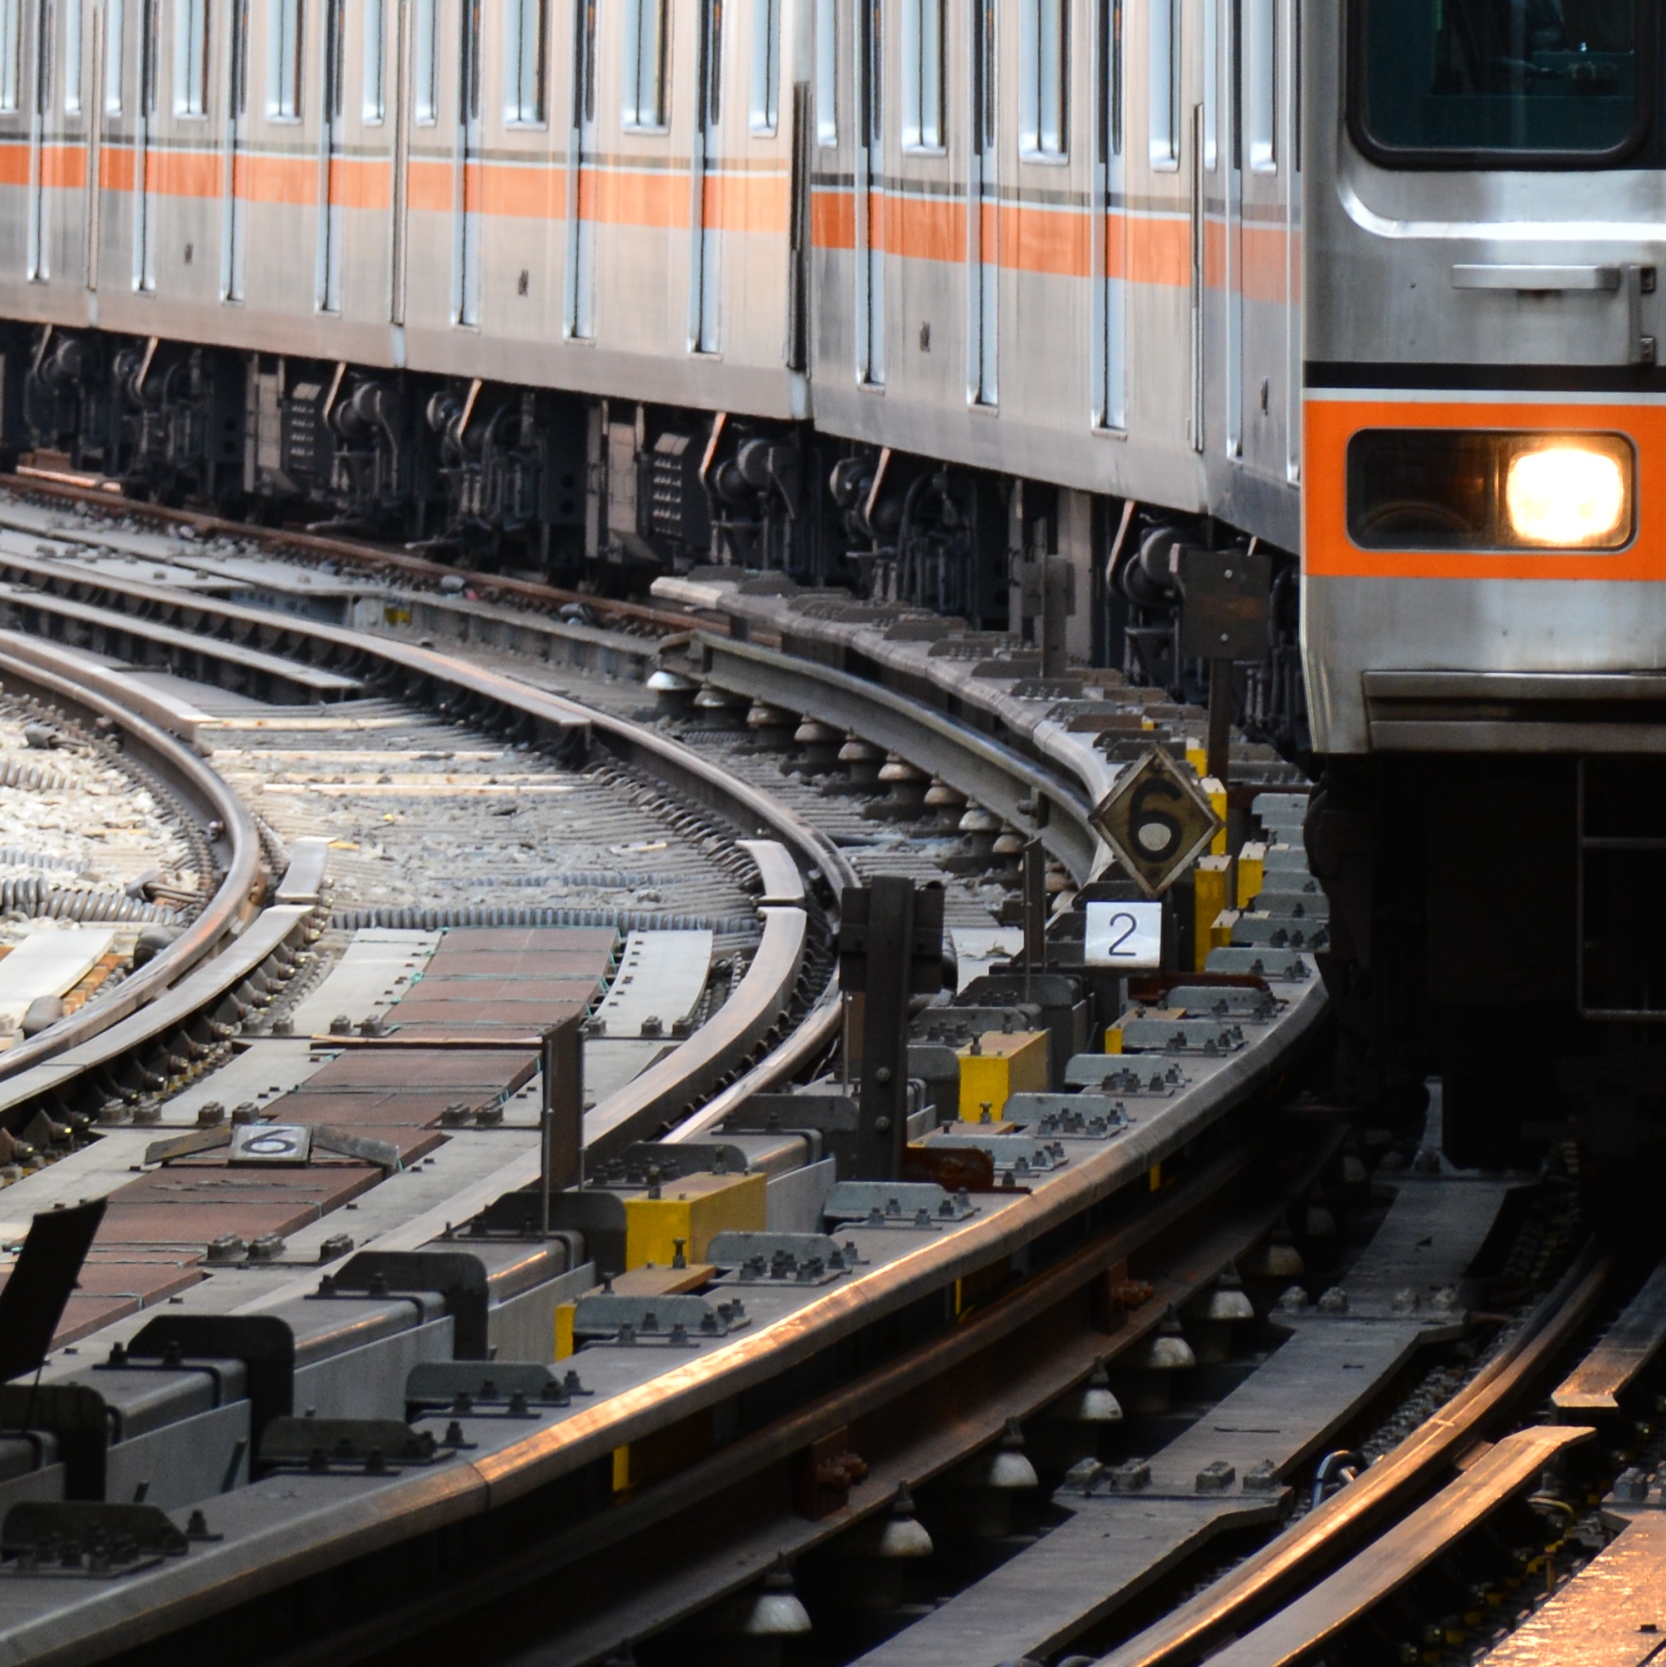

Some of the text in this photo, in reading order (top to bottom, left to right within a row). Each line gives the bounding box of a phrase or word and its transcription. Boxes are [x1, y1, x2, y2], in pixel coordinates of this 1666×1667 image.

[1129, 777, 1183, 863] 6
[1108, 912, 1137, 956] 2
[240, 1128, 296, 1154] 6
